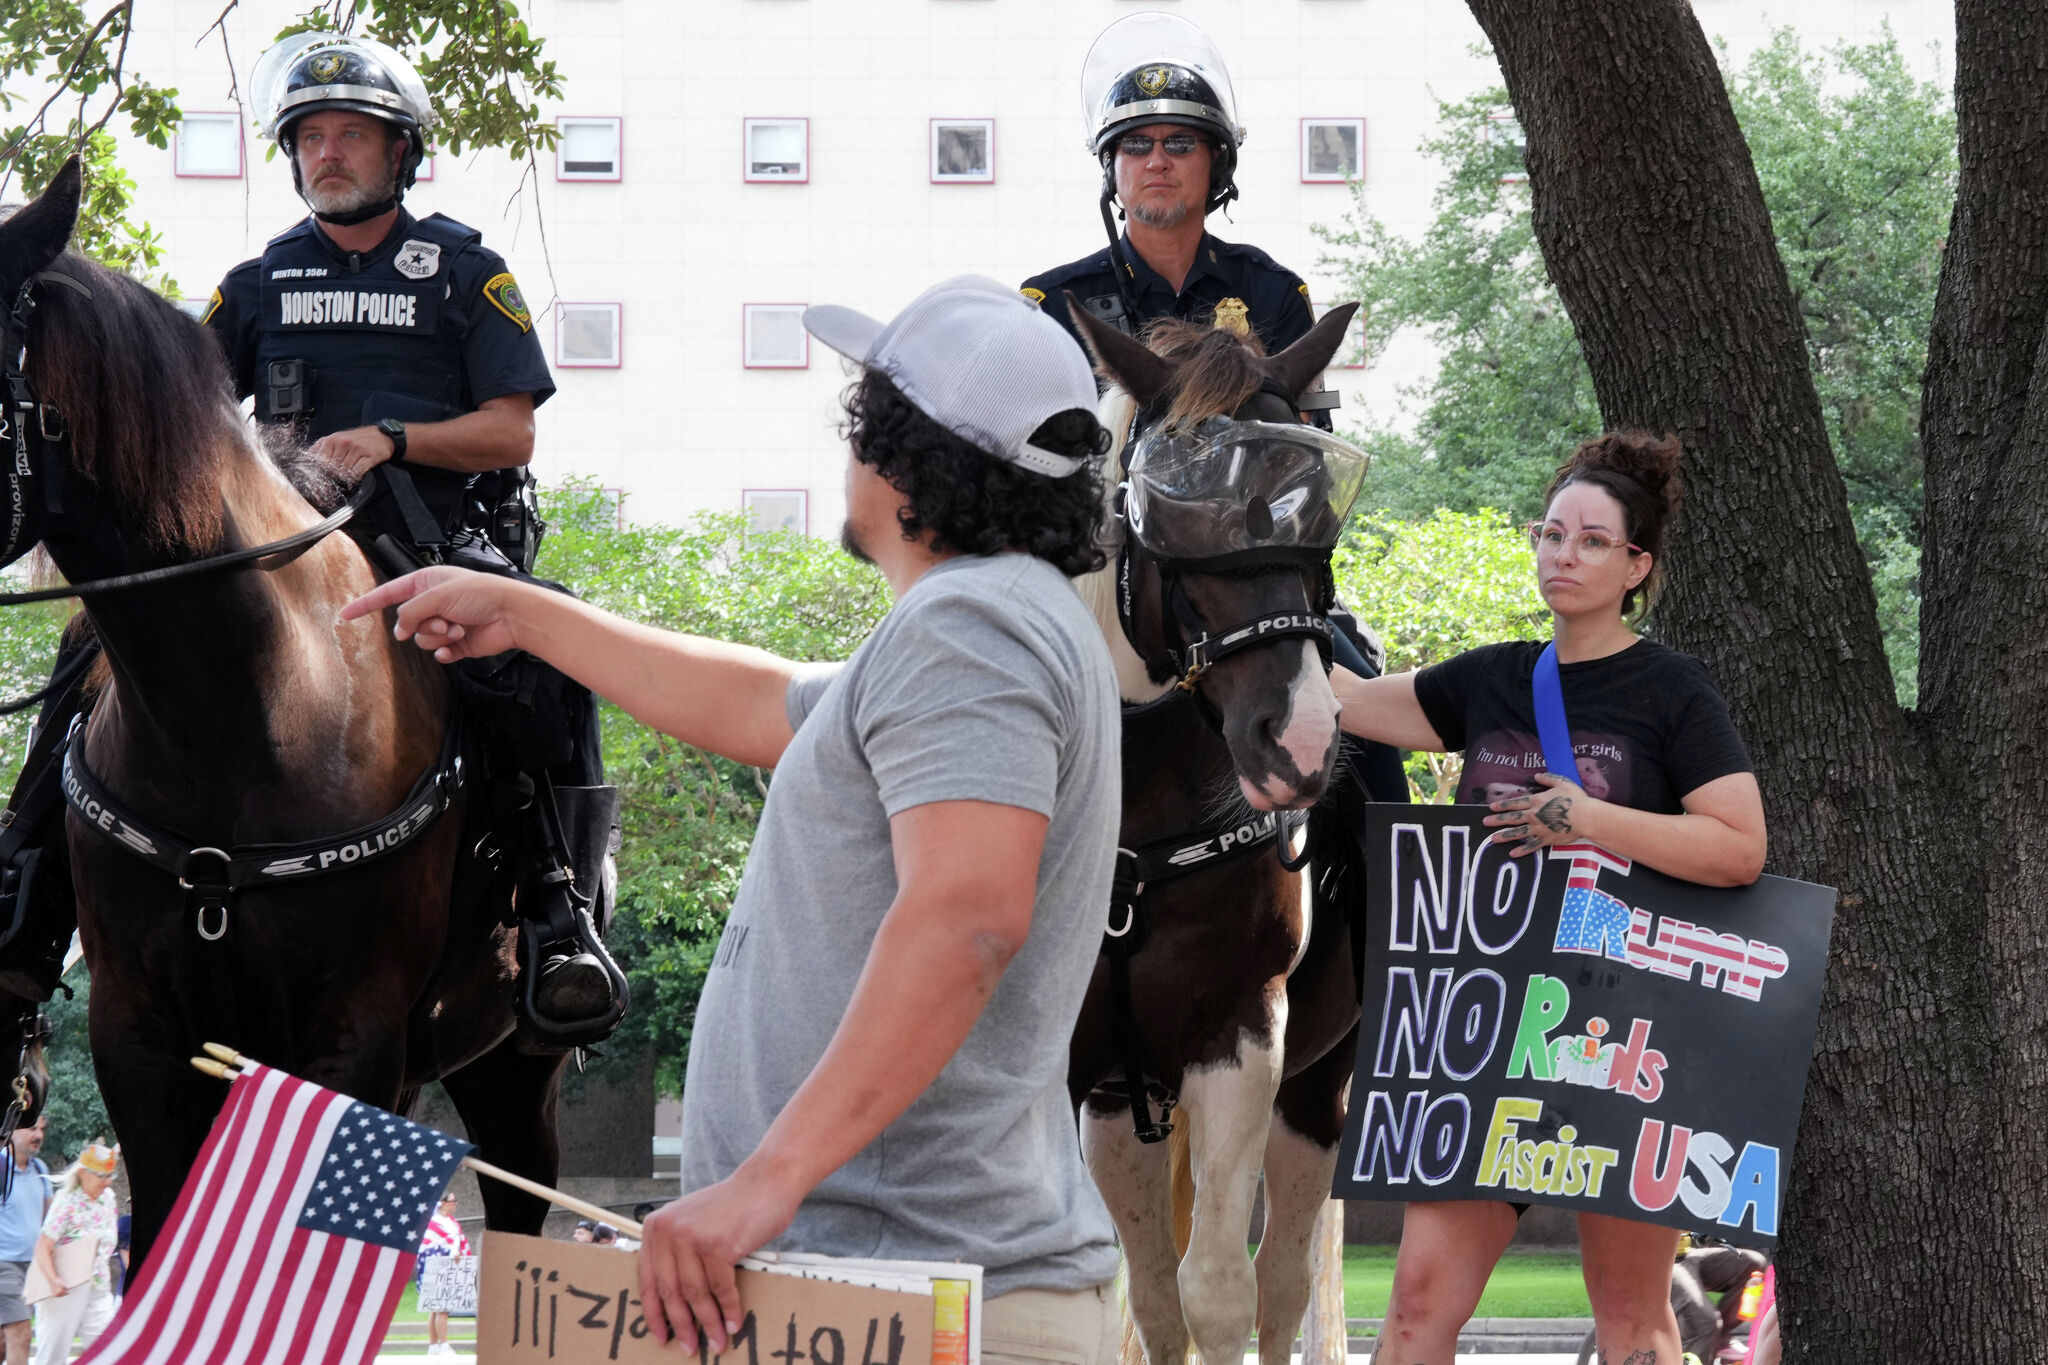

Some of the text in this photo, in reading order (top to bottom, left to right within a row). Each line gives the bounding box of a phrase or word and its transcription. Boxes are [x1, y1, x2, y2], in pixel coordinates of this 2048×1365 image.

[280, 291, 417, 327] HOUSTON POLICE
[1495, 754, 1519, 768] not
[1591, 743, 1622, 763] girls
[64, 768, 115, 831] POLICE
[319, 819, 411, 869] POLICE
[1219, 811, 1276, 852] POLI
[1389, 823, 1543, 955] NO
[1373, 966, 1668, 1103] NO Raids
[1353, 1090, 1470, 1186] NO
[1629, 1118, 1780, 1236] USA
[447, 1257, 472, 1270] IE
[422, 1296, 477, 1312] RESISTAN
[435, 1284, 474, 1300] UNDER
